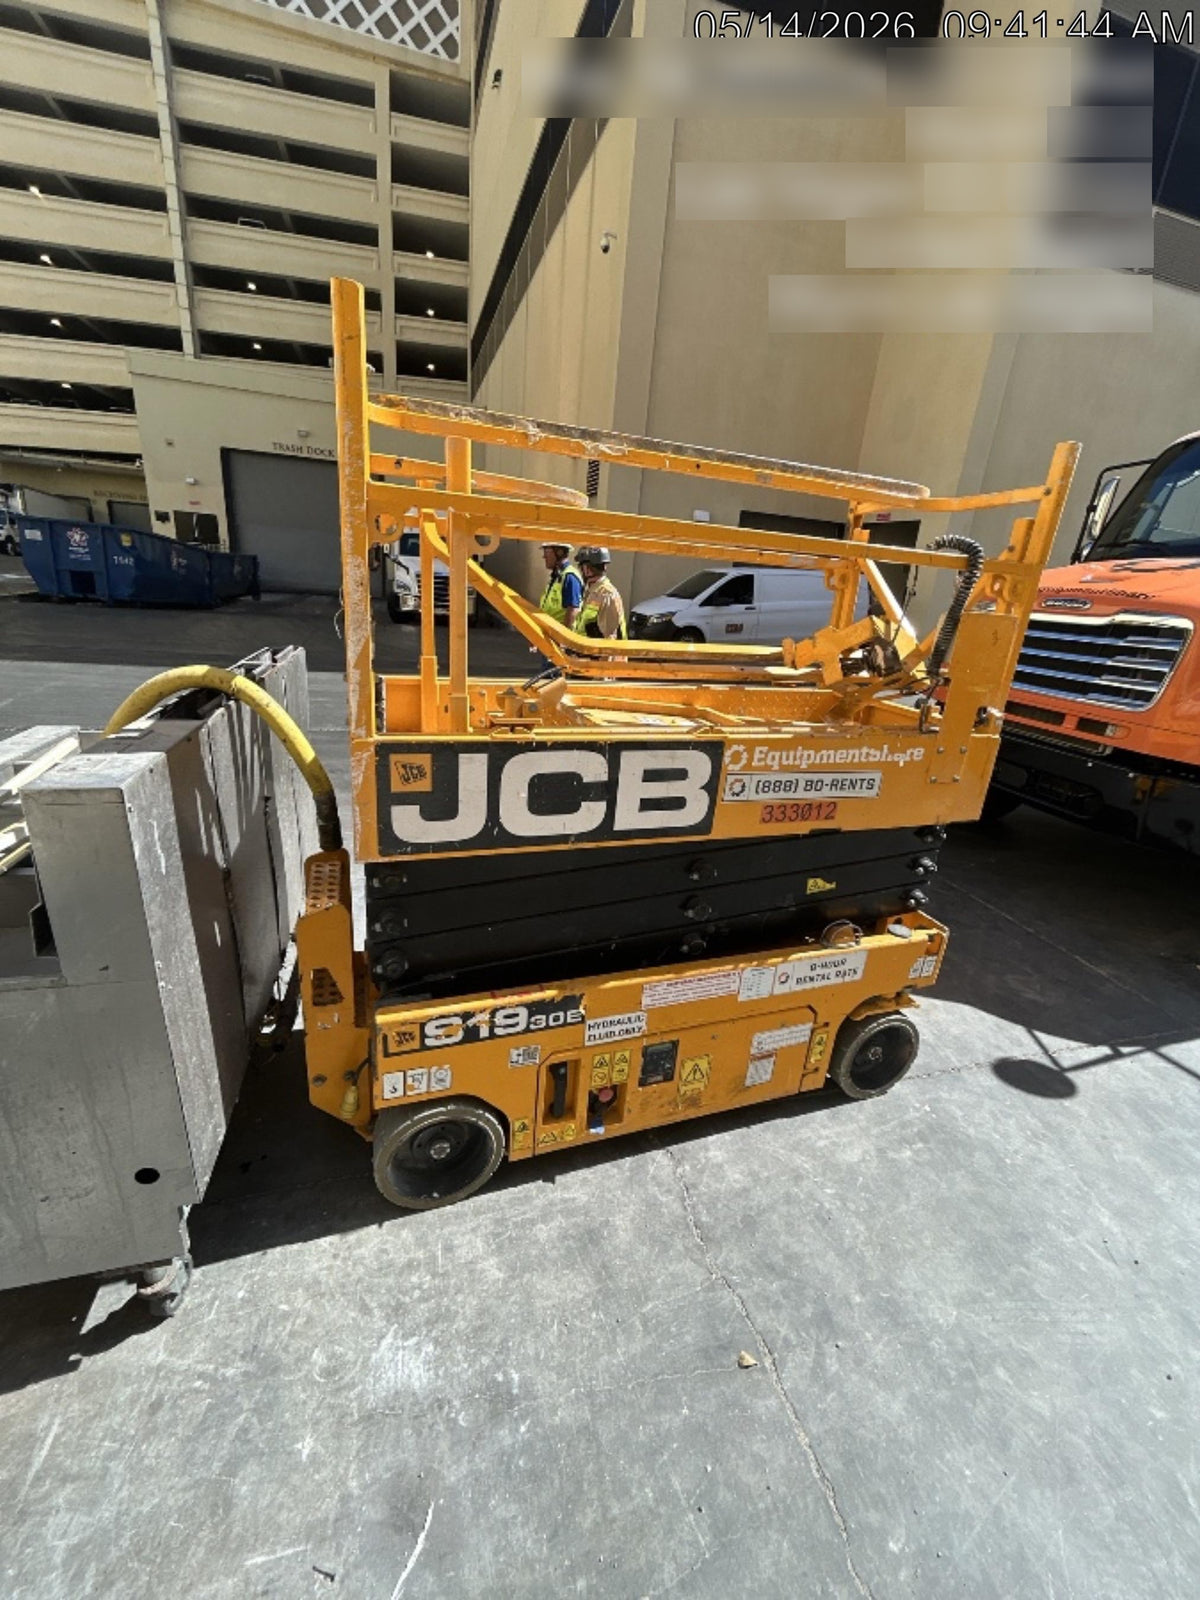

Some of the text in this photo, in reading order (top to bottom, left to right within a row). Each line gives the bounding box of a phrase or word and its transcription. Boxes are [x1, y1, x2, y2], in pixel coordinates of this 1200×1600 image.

[272, 441, 335, 458] TRASH DOCK
[395, 761, 427, 785] JCB
[390, 750, 713, 844] JCB
[755, 779, 799, 794] (888)
[762, 801, 837, 824] 333012
